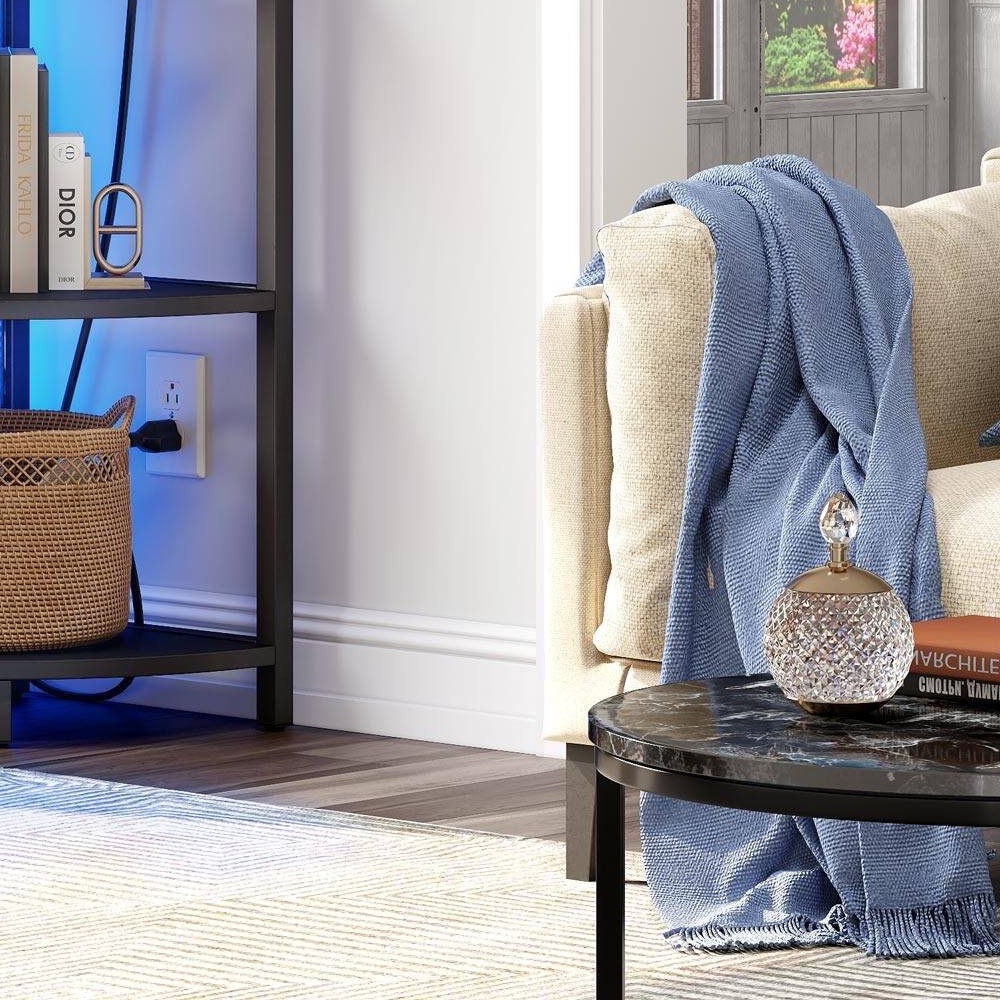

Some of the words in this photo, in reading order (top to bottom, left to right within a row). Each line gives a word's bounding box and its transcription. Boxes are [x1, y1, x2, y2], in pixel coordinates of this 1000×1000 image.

[17, 114, 32, 165] FRIDA
[17, 175, 32, 237] KAHLO
[58, 188, 76, 238] DIOR
